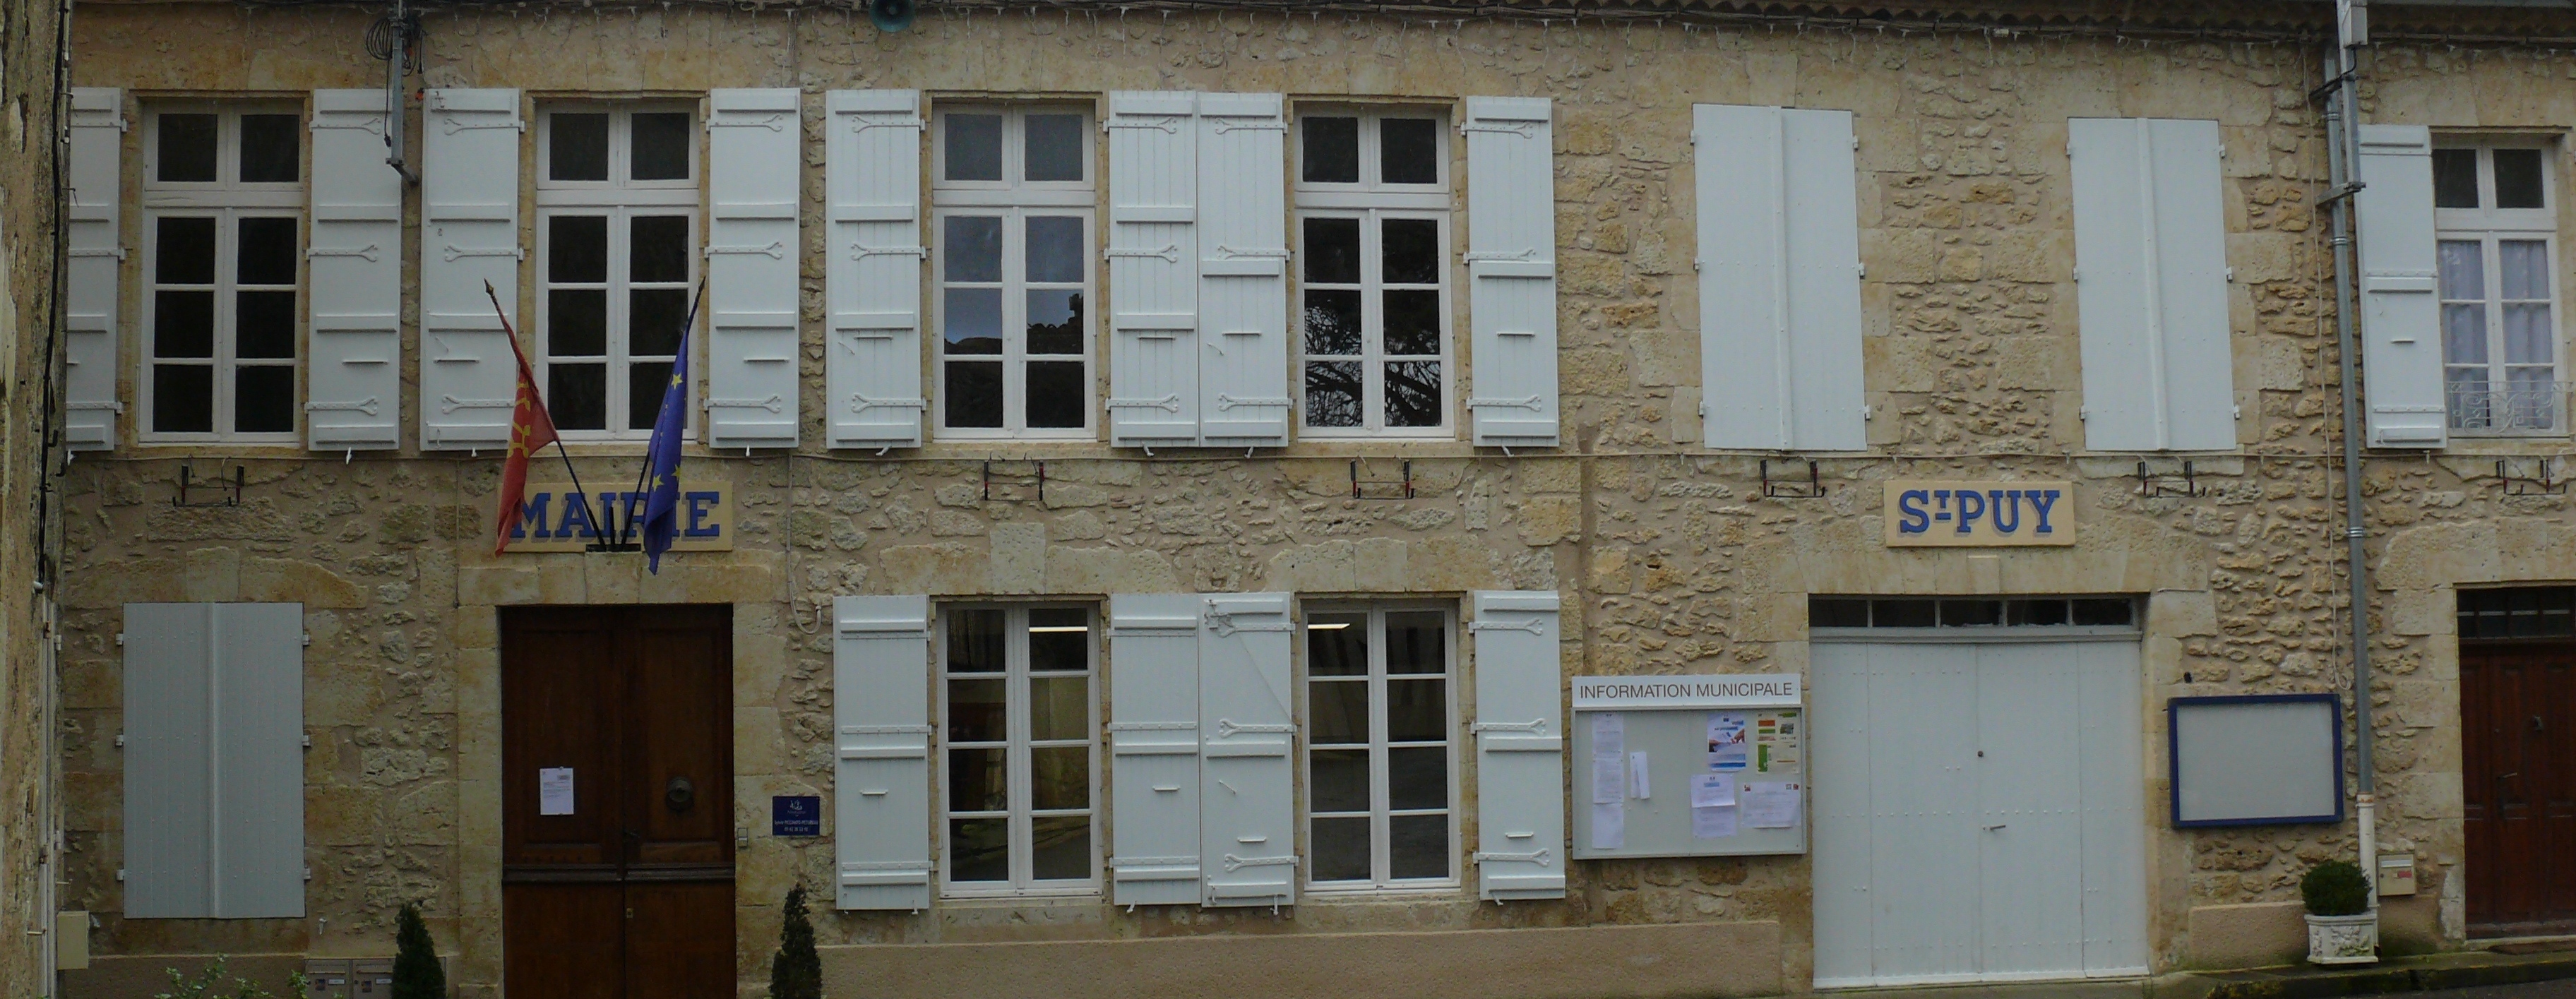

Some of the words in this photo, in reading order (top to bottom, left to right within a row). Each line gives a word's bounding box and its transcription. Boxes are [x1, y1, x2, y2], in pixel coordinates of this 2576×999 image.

[510, 491, 720, 539] MAIRE
[1580, 683, 1691, 699] INFORMATION
[1696, 682, 1793, 698] MUNICIPALE
